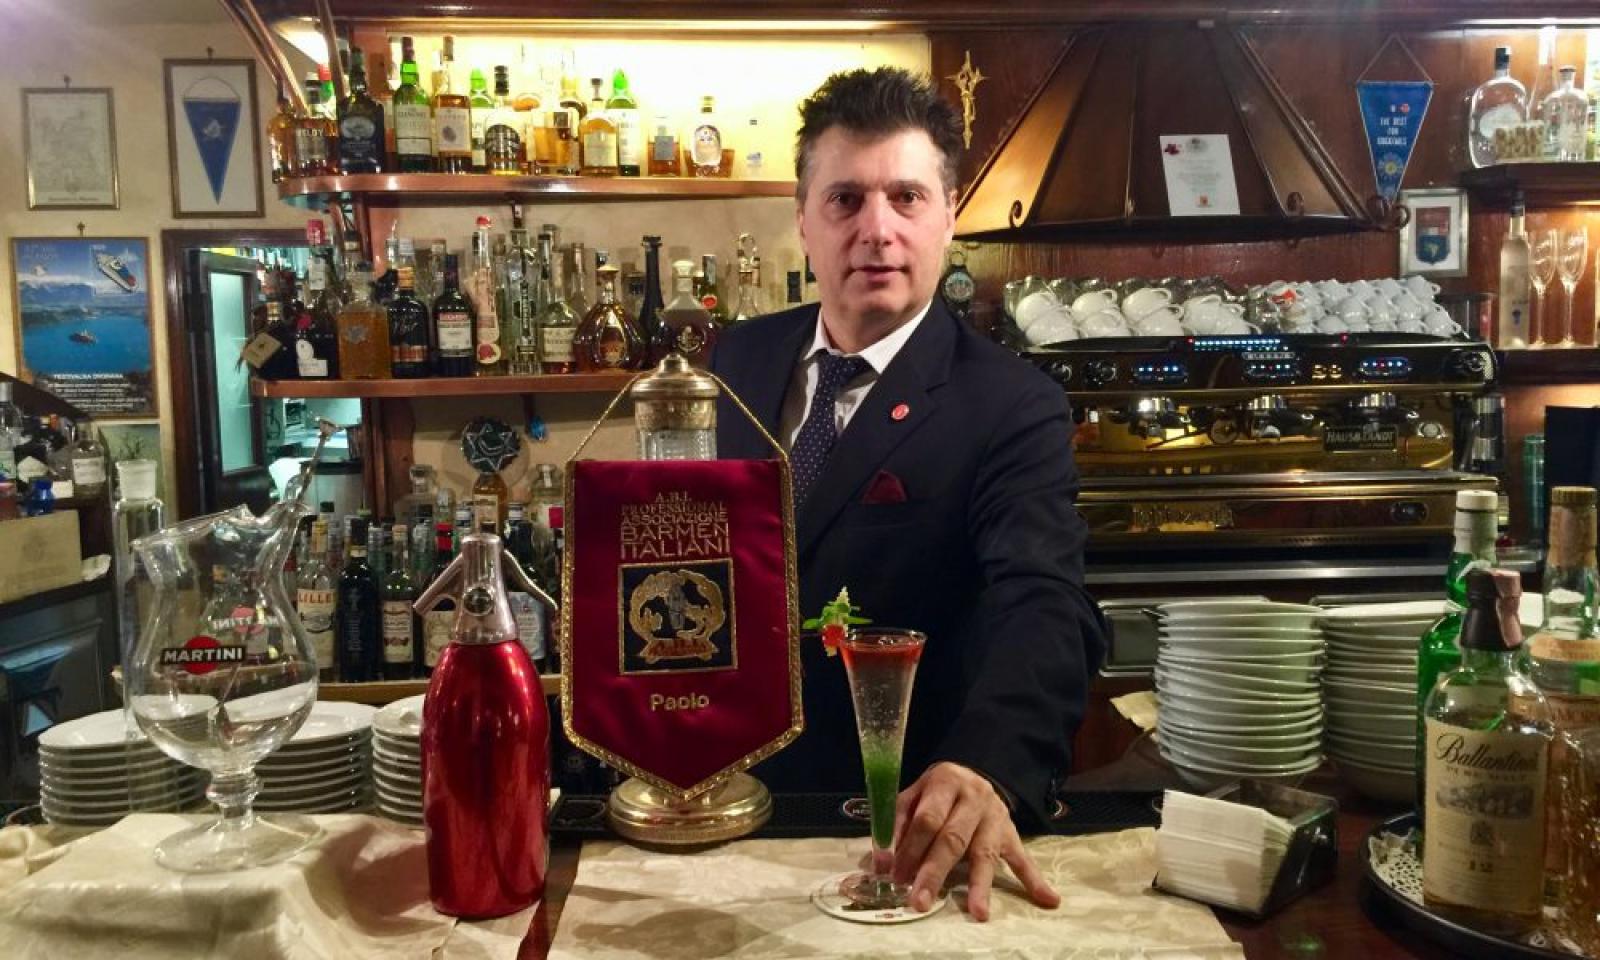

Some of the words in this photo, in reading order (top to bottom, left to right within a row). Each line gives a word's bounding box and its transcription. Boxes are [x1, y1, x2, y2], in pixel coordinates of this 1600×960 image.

[621, 501, 728, 515] PROFESSIONAL
[621, 511, 729, 526] ASSOCIAZIONE
[620, 522, 729, 542] BARMEN
[620, 537, 731, 559] ITALIANI
[164, 647, 243, 662] MARTINI
[650, 692, 710, 711] Paolo
